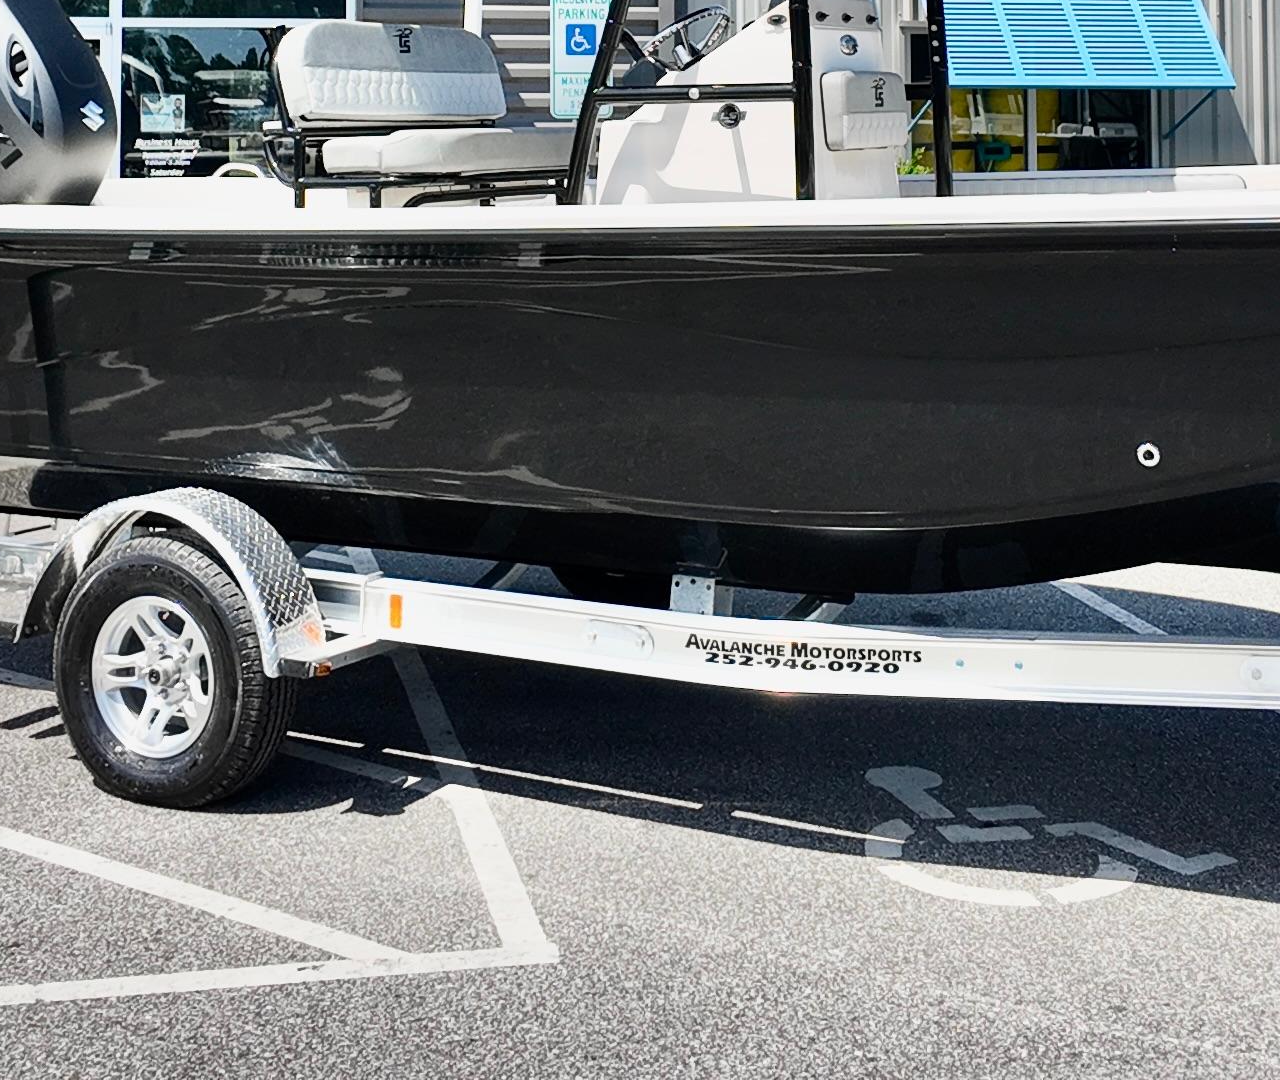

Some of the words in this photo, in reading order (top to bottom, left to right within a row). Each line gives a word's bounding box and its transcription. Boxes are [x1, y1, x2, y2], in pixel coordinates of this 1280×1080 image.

[558, 8, 606, 20] PARKING
[685, 633, 786, 657] AVALANCHE
[790, 641, 922, 663] MOTORSPORTS
[704, 651, 900, 674] 252-946-0920
